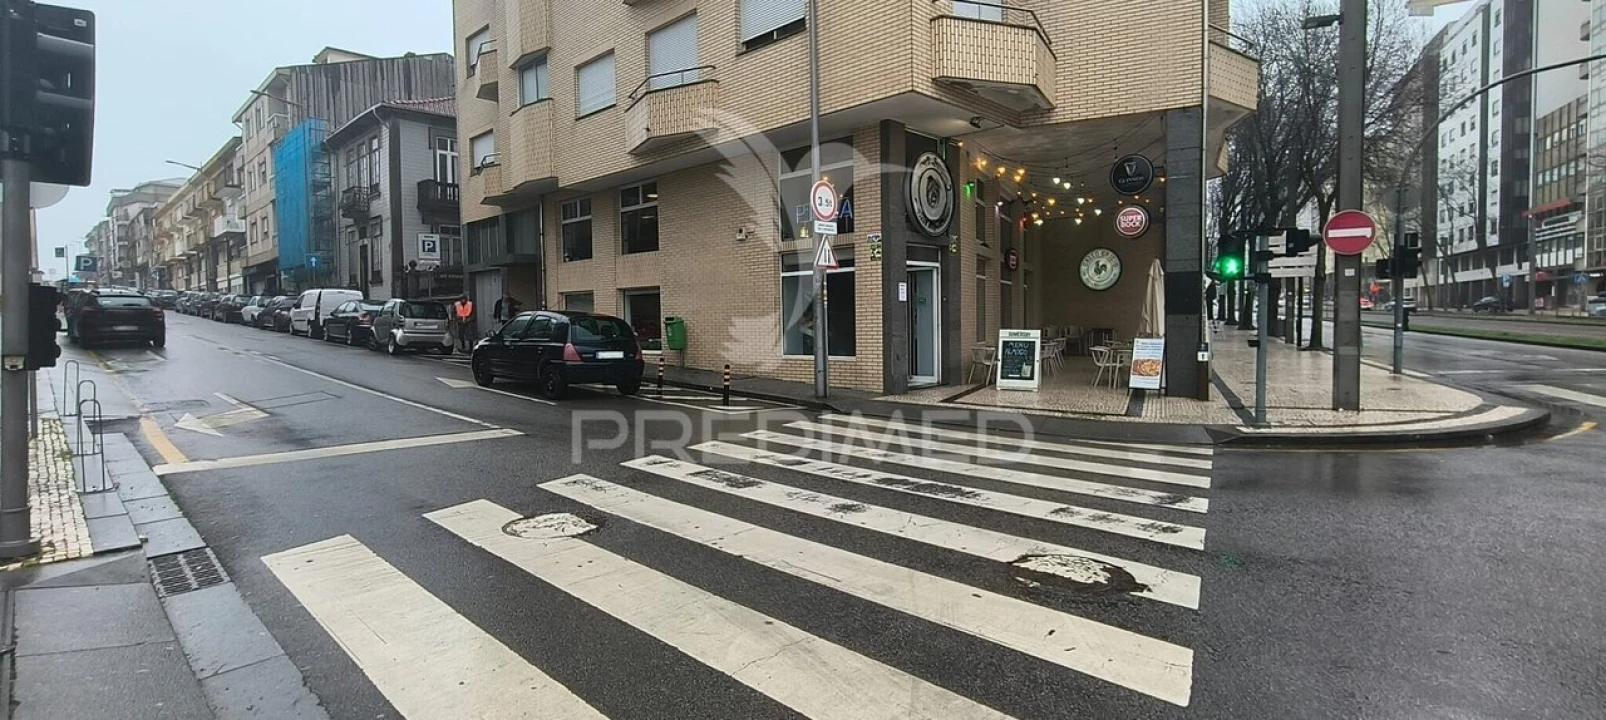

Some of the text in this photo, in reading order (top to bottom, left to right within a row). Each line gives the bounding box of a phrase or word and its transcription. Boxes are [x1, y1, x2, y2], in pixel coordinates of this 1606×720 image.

[1118, 176, 1144, 184] GUINNESS
[424, 241, 434, 252] P
[80, 257, 93, 270] P
